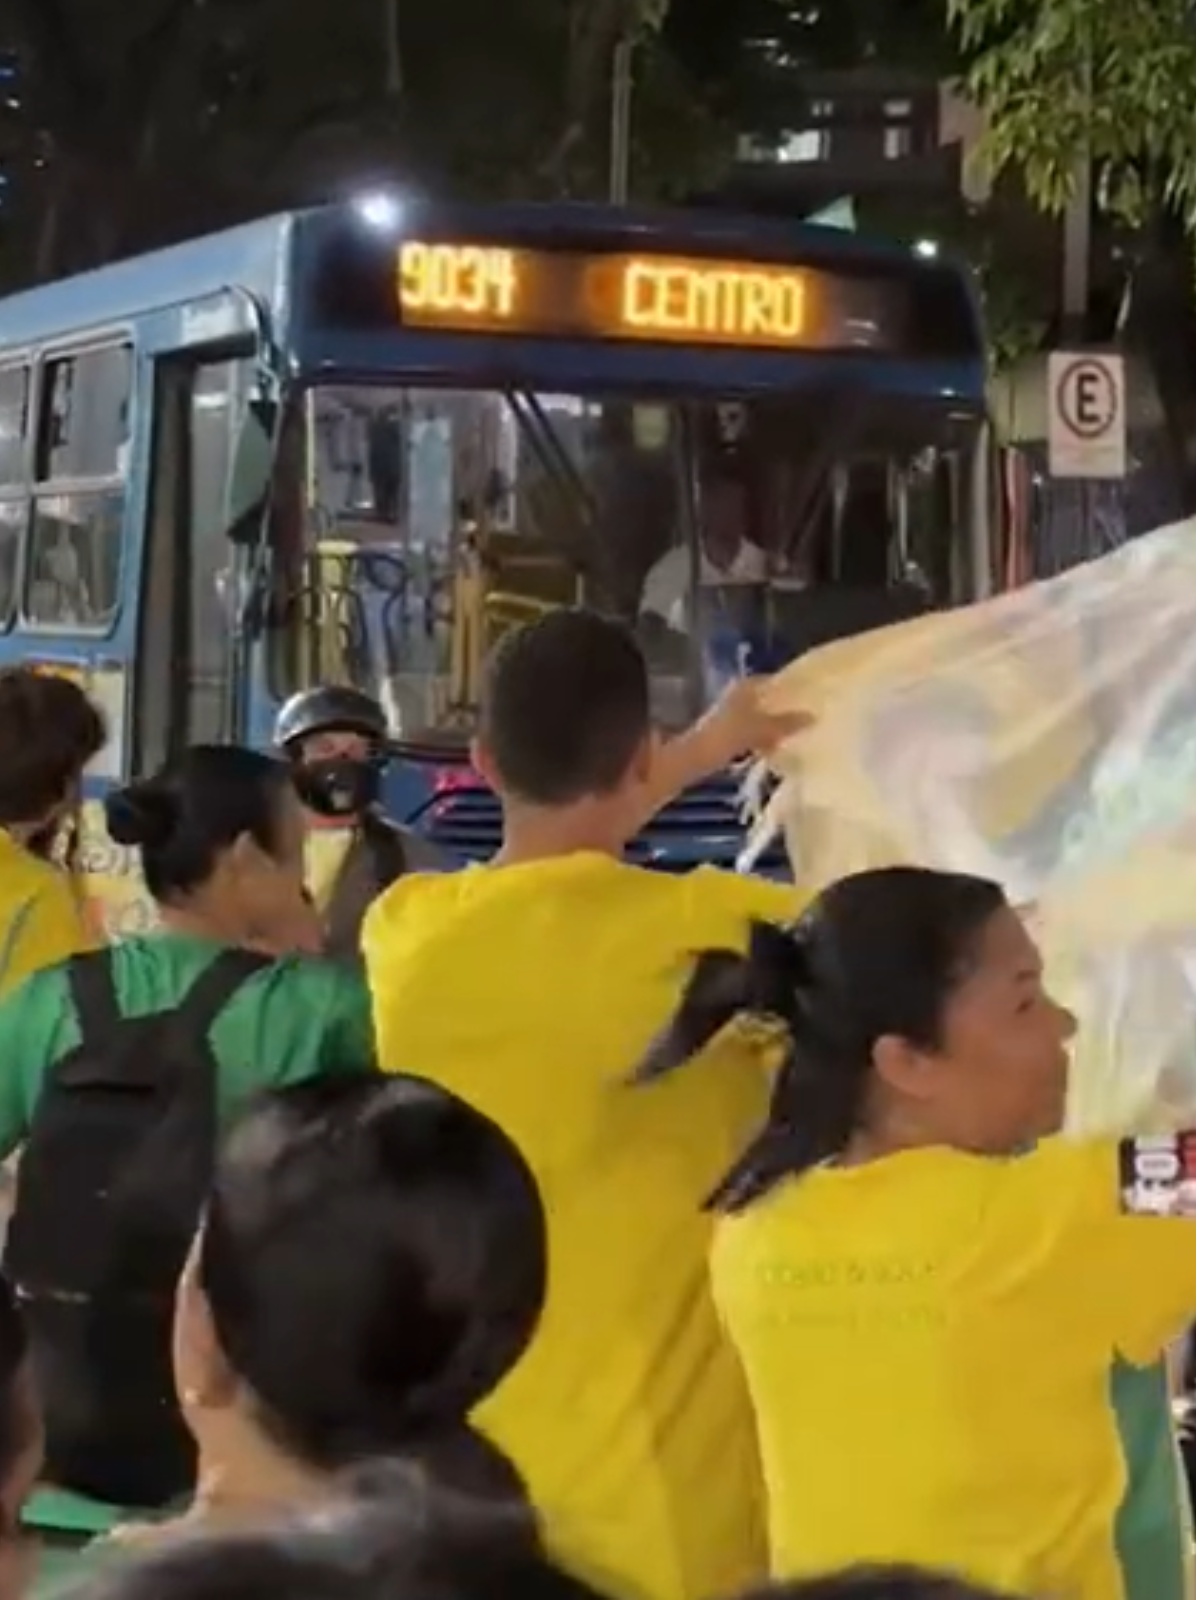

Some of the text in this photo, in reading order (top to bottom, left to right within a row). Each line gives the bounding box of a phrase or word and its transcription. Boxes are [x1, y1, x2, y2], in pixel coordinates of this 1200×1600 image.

[399, 242, 804, 336] 9034 CENTRO
[1077, 374, 1100, 422] E
